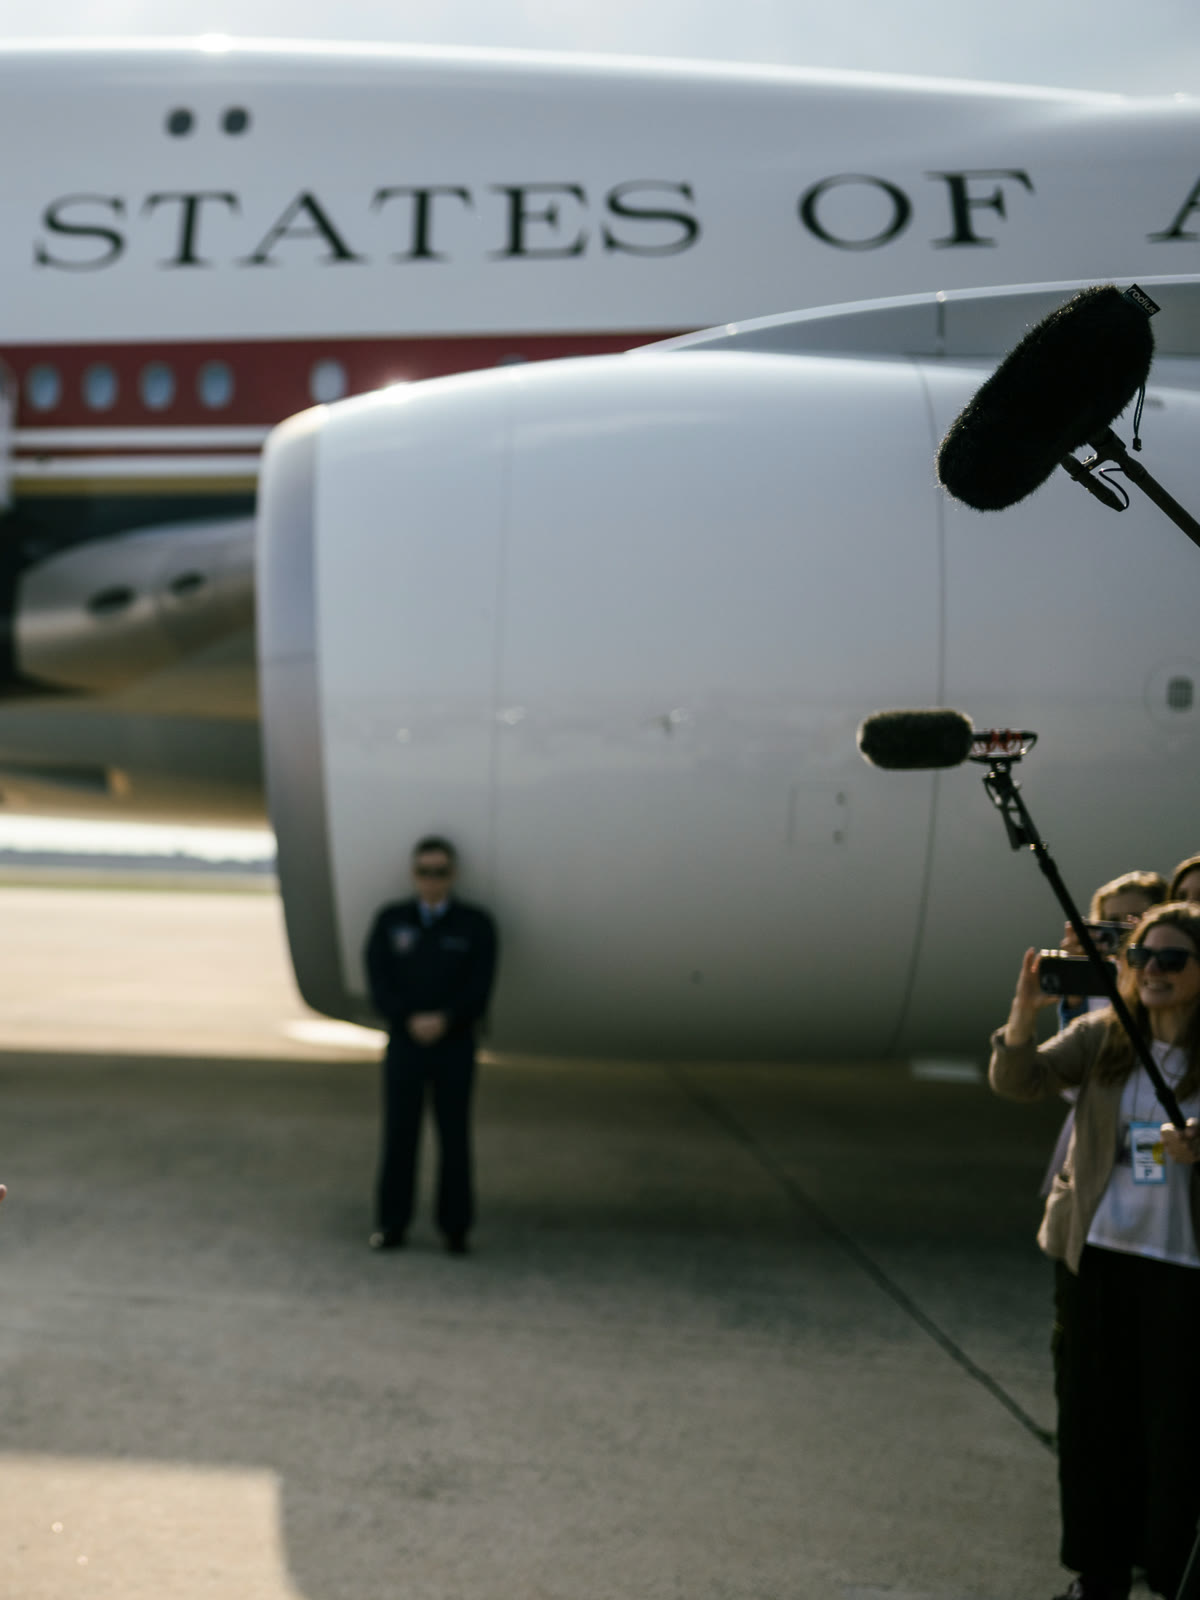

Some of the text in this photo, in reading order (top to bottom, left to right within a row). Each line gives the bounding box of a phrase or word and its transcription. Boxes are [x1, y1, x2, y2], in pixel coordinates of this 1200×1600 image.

[33, 180, 702, 272] STATES
[796, 168, 1035, 251] OF
[1128, 288, 1156, 314] radius
